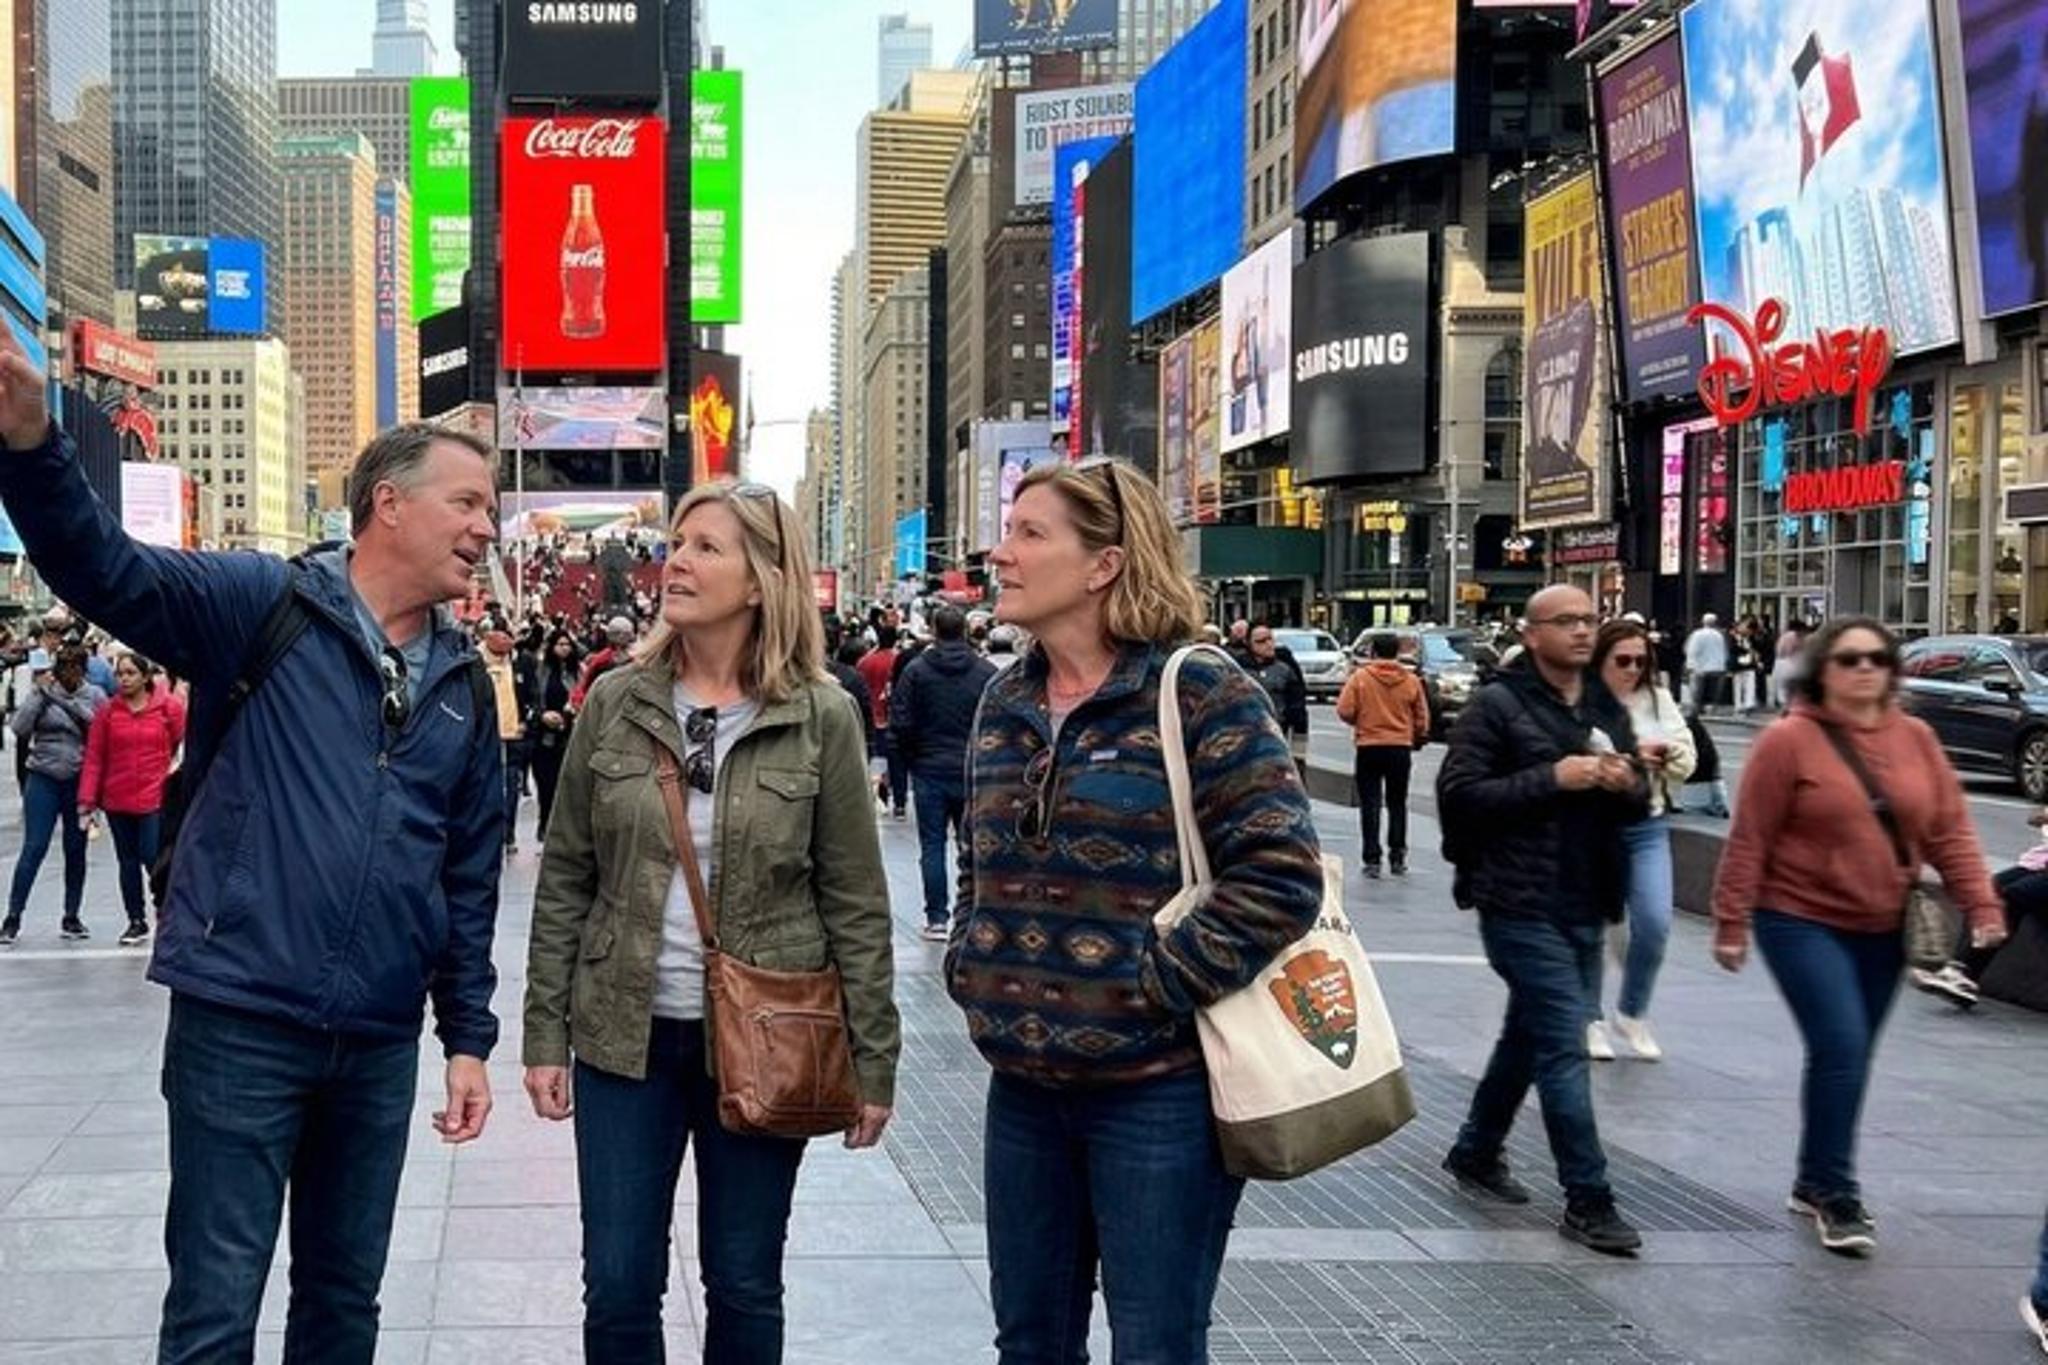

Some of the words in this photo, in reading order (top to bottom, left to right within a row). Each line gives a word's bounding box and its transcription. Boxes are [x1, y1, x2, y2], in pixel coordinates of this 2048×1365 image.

[528, 3, 638, 23] SAMSUNG
[525, 118, 643, 158] Coca-Cola
[1297, 332, 1408, 382] SAMSUNG
[1786, 461, 1904, 513] BROADWAY
